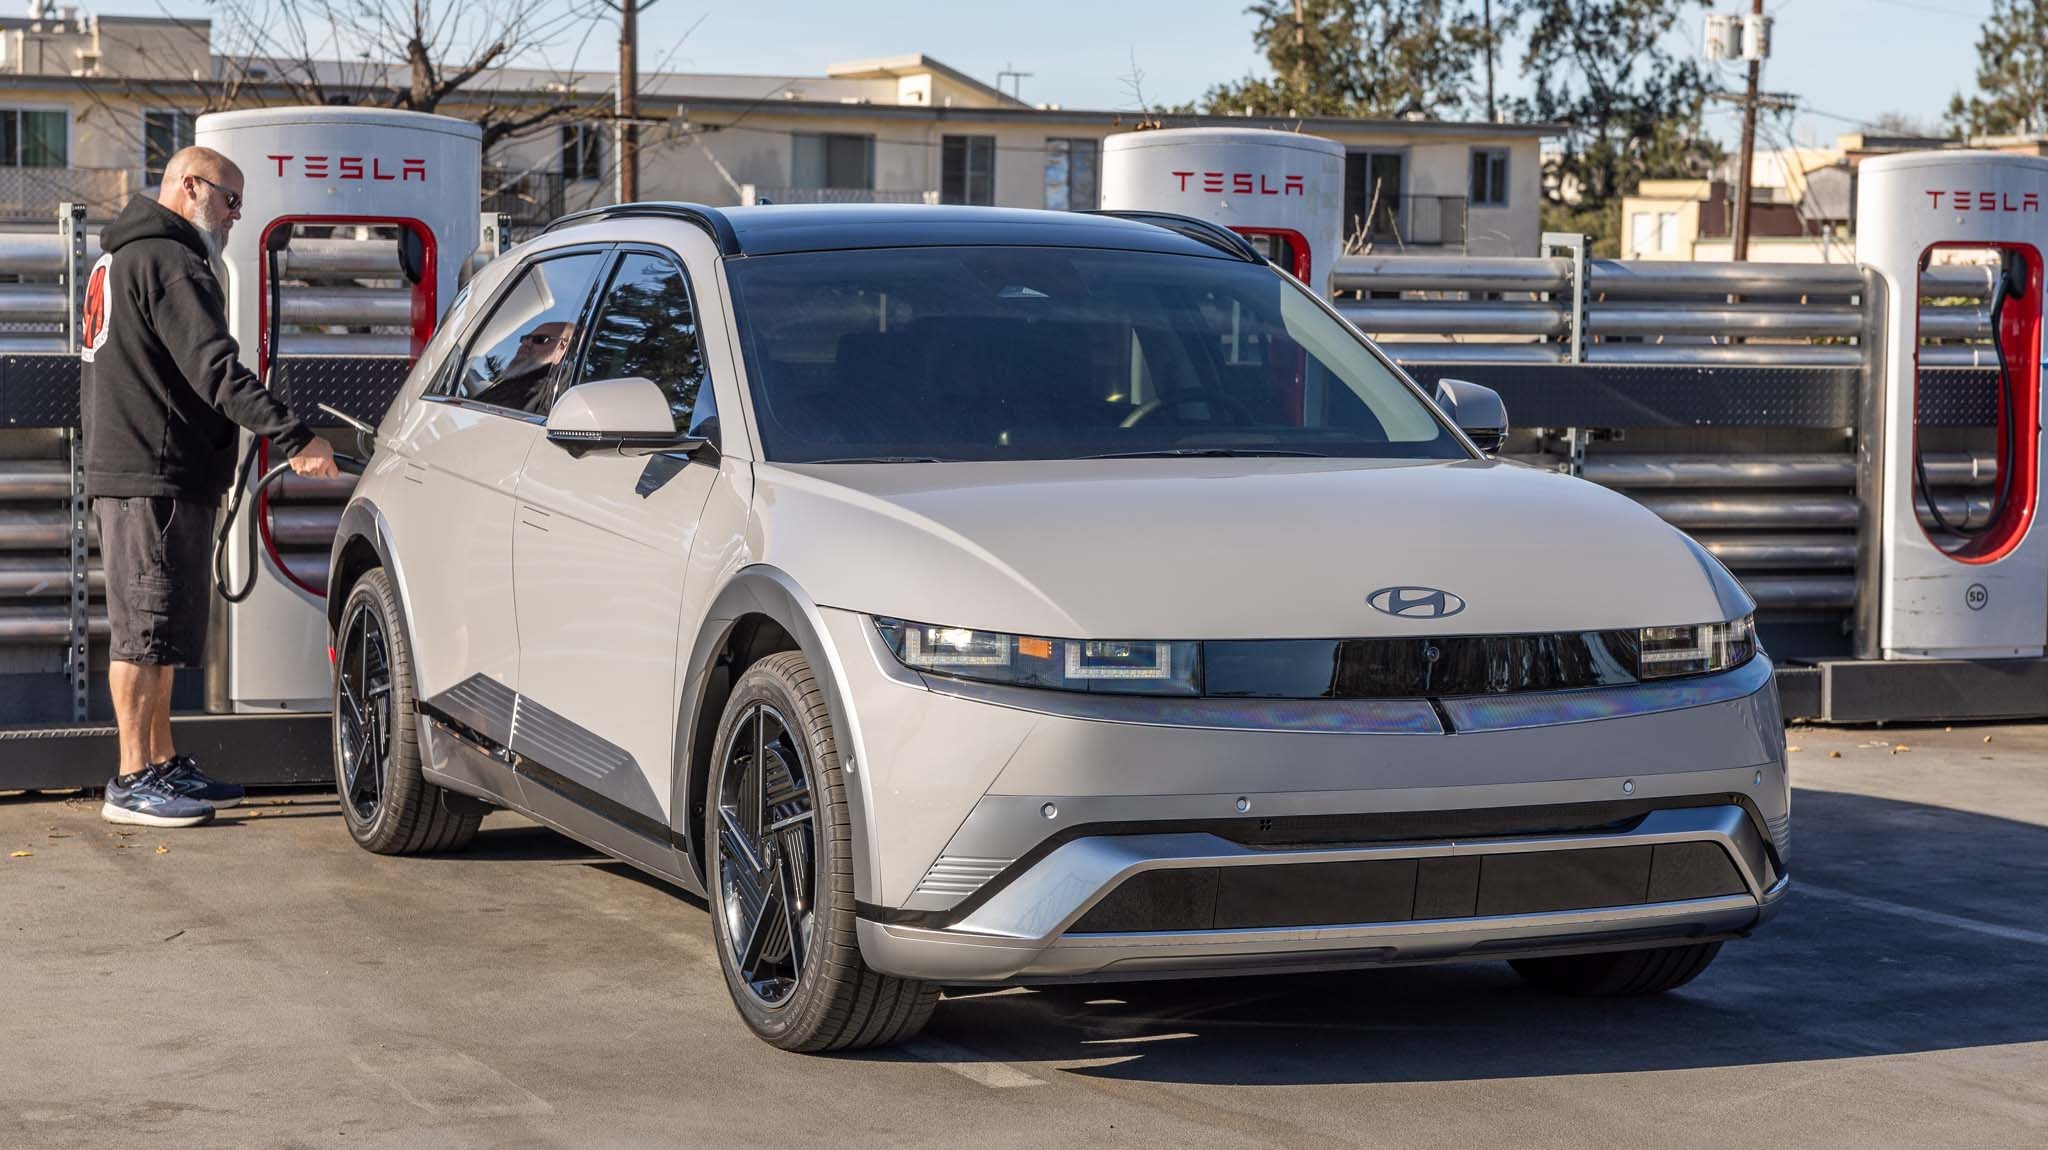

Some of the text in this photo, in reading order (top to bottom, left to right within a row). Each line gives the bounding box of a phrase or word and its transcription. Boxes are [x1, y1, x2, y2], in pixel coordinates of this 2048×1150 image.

[267, 154, 426, 182] TESLA
[1171, 171, 1304, 196] TESLA
[1925, 190, 2039, 212] TESLA
[1969, 590, 1985, 602] 5D
